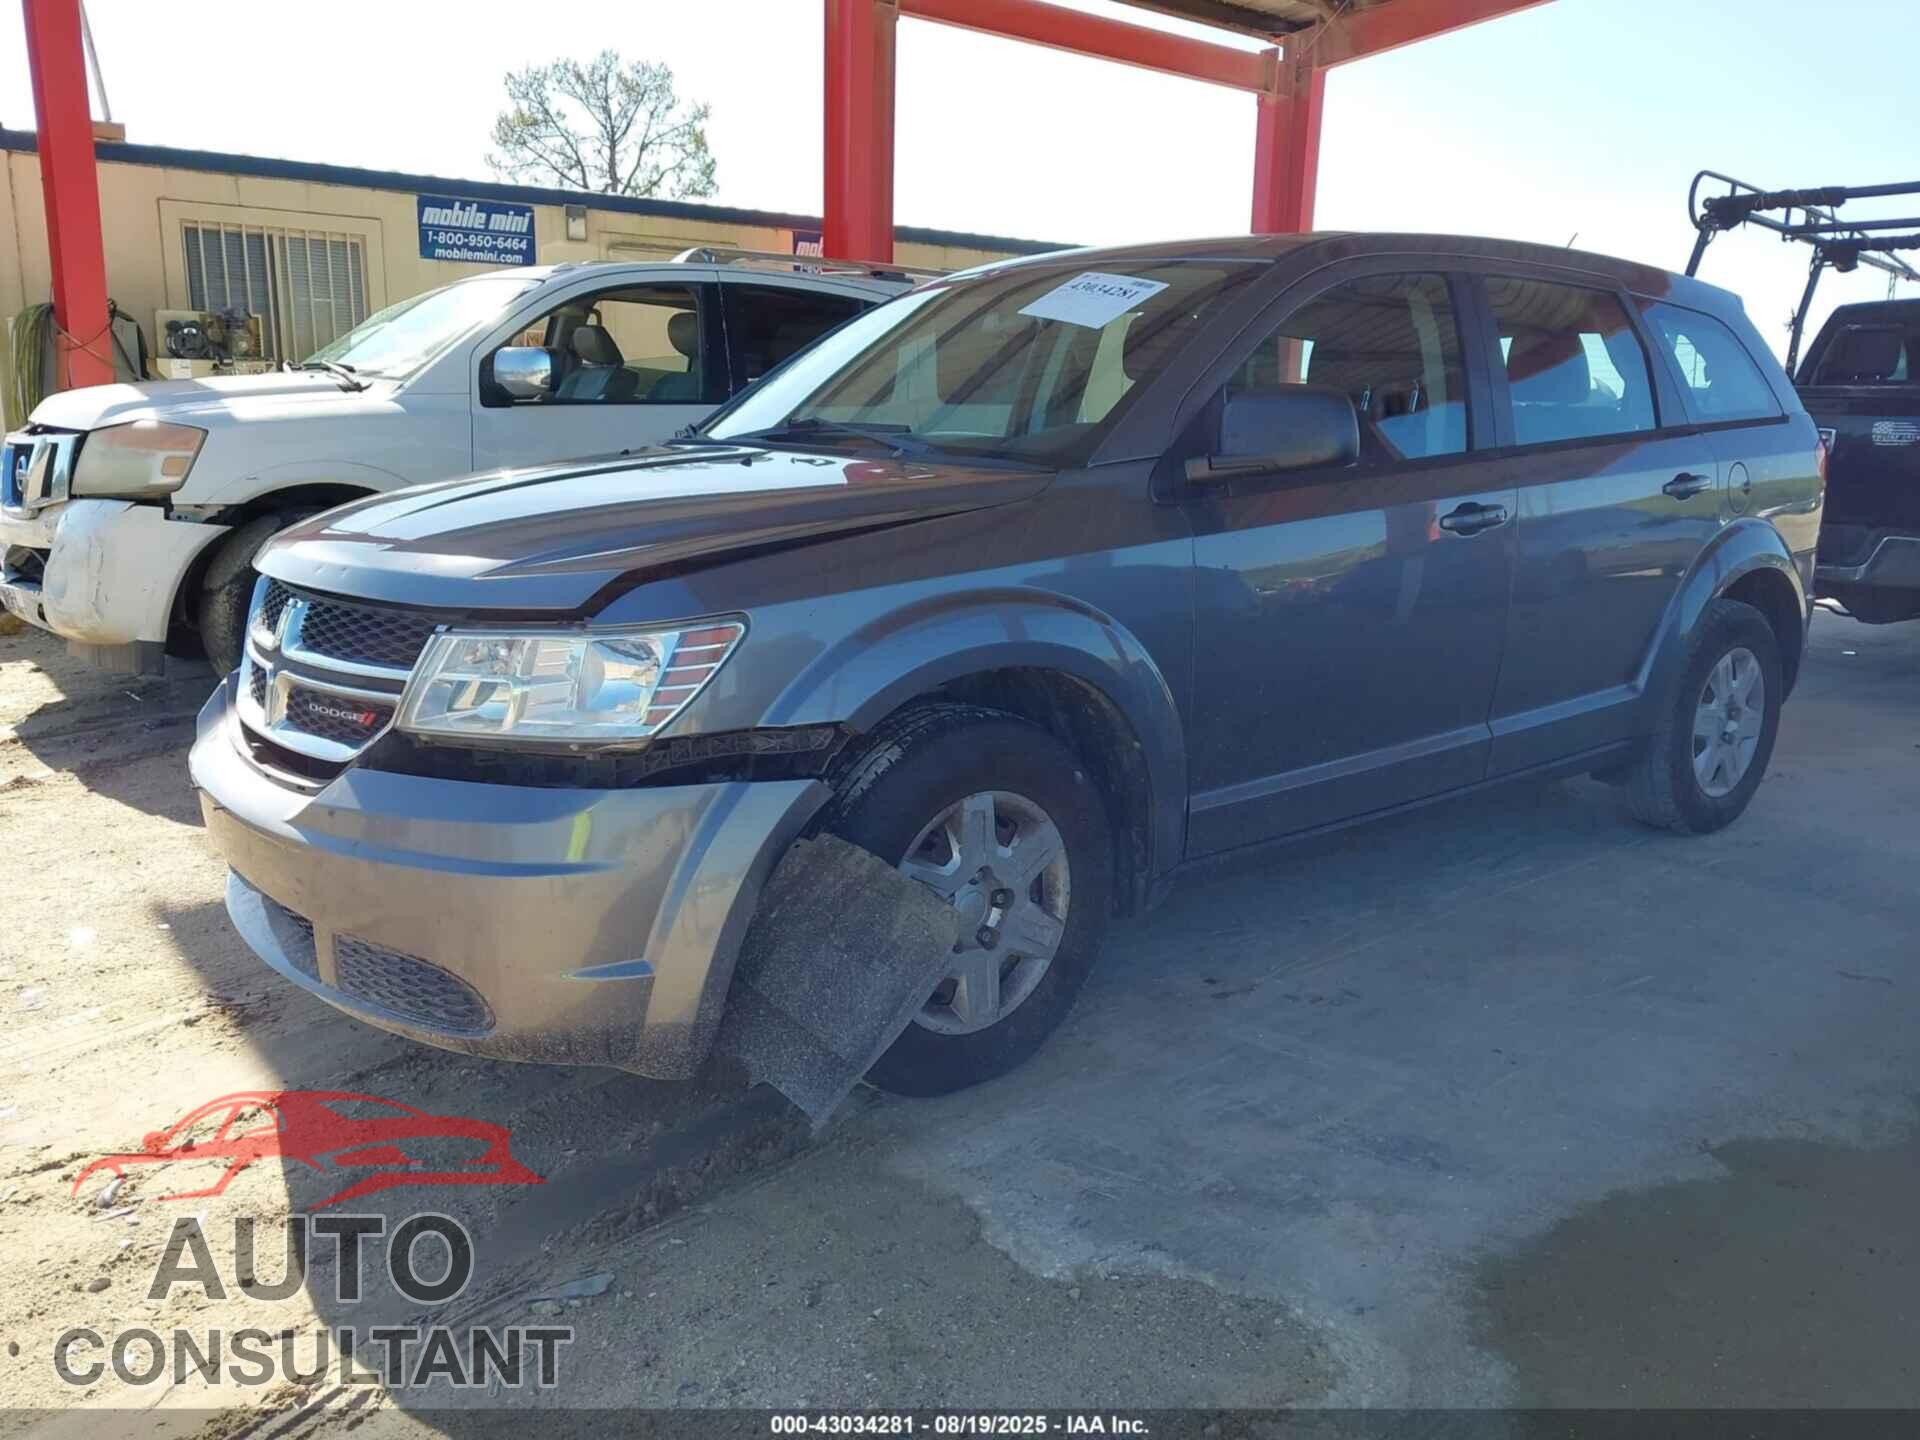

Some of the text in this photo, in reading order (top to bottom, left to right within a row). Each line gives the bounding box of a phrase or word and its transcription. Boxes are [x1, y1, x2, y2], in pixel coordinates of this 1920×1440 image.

[422, 201, 532, 232] mobile mini
[427, 231, 527, 250] 1-800-950-6464
[434, 247, 523, 263] mobilemini.com
[309, 703, 364, 722] DODGE
